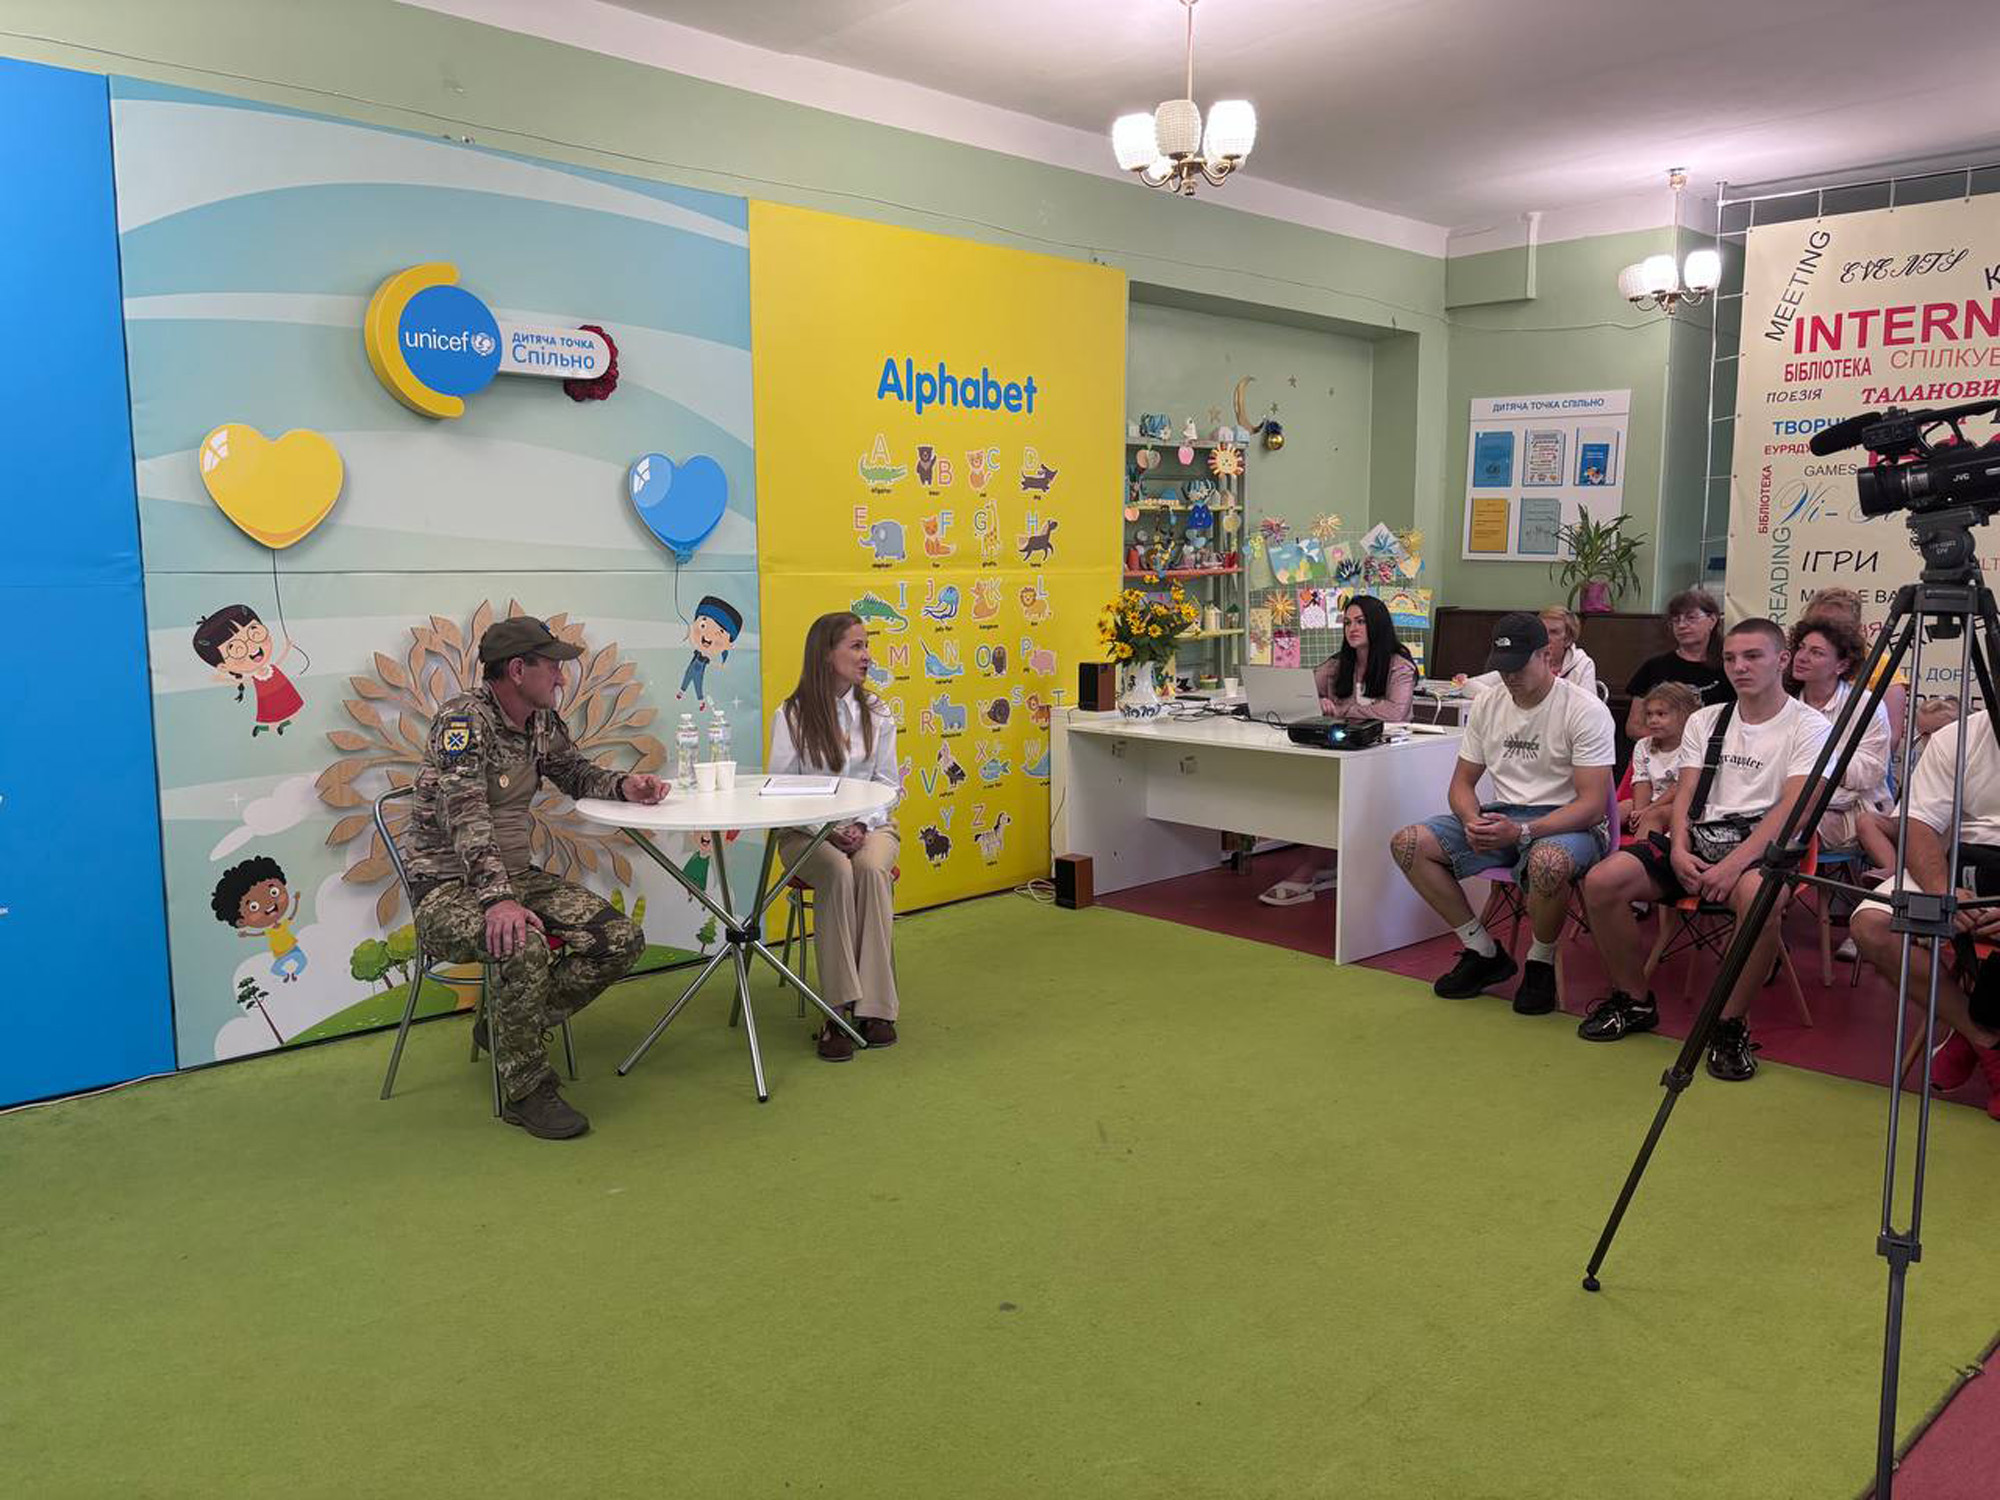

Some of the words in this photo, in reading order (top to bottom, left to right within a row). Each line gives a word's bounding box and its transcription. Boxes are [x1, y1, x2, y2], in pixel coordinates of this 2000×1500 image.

[1840, 249, 1969, 283] EVENTS
[1765, 231, 1831, 342] MEETING
[1793, 298, 2000, 355] INTERN
[405, 329, 469, 351] unicef
[512, 332, 556, 345] ДИТЯЧА
[560, 337, 595, 349] ТОЧКА
[512, 344, 595, 369] Спільно
[1784, 357, 1872, 383] БІБЛІОТЕКА
[877, 357, 1038, 415] Alphabet
[1766, 389, 1823, 404] ПОЕЗІЯ
[1492, 402, 1529, 413] ДИТЯЧА
[1531, 401, 1560, 411] ТОЧКА
[872, 434, 891, 465] A
[986, 447, 1002, 471] C
[938, 458, 953, 486] B
[1804, 463, 1858, 477] GAMES
[1758, 464, 1773, 534] БІБЛІОТЕКА
[853, 505, 868, 531] E
[940, 510, 954, 539] F
[974, 509, 987, 533] G
[1027, 511, 1038, 537] H
[1802, 551, 1878, 573] ІГРИ
[1037, 574, 1050, 598] L
[1767, 527, 1792, 626] READING
[899, 581, 908, 609] I
[925, 578, 935, 602] J
[888, 643, 910, 669] M
[943, 639, 960, 665] N
[976, 644, 991, 669] O
[1020, 636, 1033, 660] P
[1011, 685, 1025, 706] S
[920, 709, 937, 737] R
[975, 740, 988, 763] X
[920, 767, 938, 795] V
[940, 805, 954, 830] Y
[972, 803, 986, 828] Z
